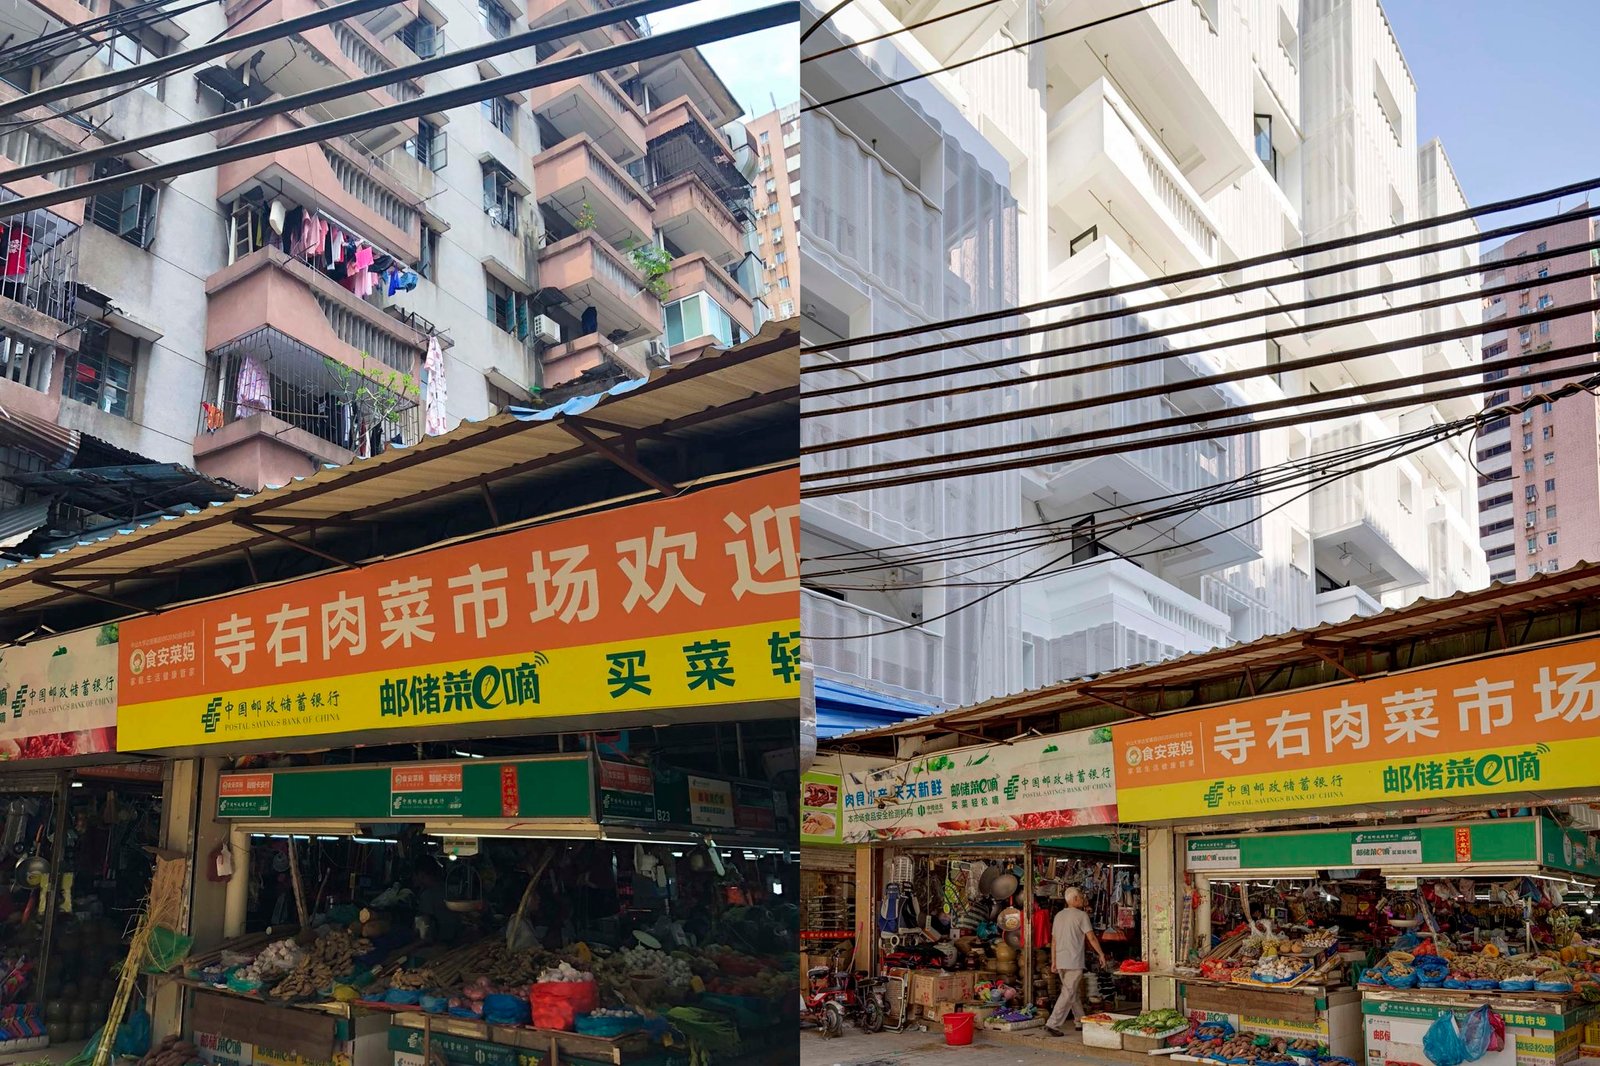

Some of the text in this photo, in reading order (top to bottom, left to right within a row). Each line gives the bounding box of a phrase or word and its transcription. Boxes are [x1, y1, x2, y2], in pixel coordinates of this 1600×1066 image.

[214, 504, 800, 675] 寺右肉菜市场欢迎
[145, 642, 195, 669] 食安菜妈
[29, 676, 114, 705] 中国邮政储蓄银行
[380, 662, 541, 717] 邮储菜e嘀
[70, 702, 85, 710] BANK
[95, 697, 114, 705] CHINA
[225, 690, 339, 720] 中国邮政储蓄银行
[1213, 662, 1600, 765] 寺右肉菜市场
[225, 713, 340, 731] POSTAL SAVINGS BANK OF CHINA
[1142, 740, 1194, 761] 食安菜妈
[1021, 767, 1110, 791] 中国邮政储蓄银行
[1383, 750, 1541, 794] 邮储菜e嘀
[894, 779, 942, 800] 天天新鲜
[1022, 791, 1043, 799] POSTAL
[1043, 789, 1066, 797] SAVINGS
[1227, 774, 1343, 798] 中国邮政储蓄银行
[1228, 799, 1253, 807] POSTAL
[1255, 797, 1284, 805] SAVINGS
[1319, 791, 1344, 799] CHINA
[656, 809, 671, 822] B23
[1501, 1013, 1547, 1027] 慧菜市场
